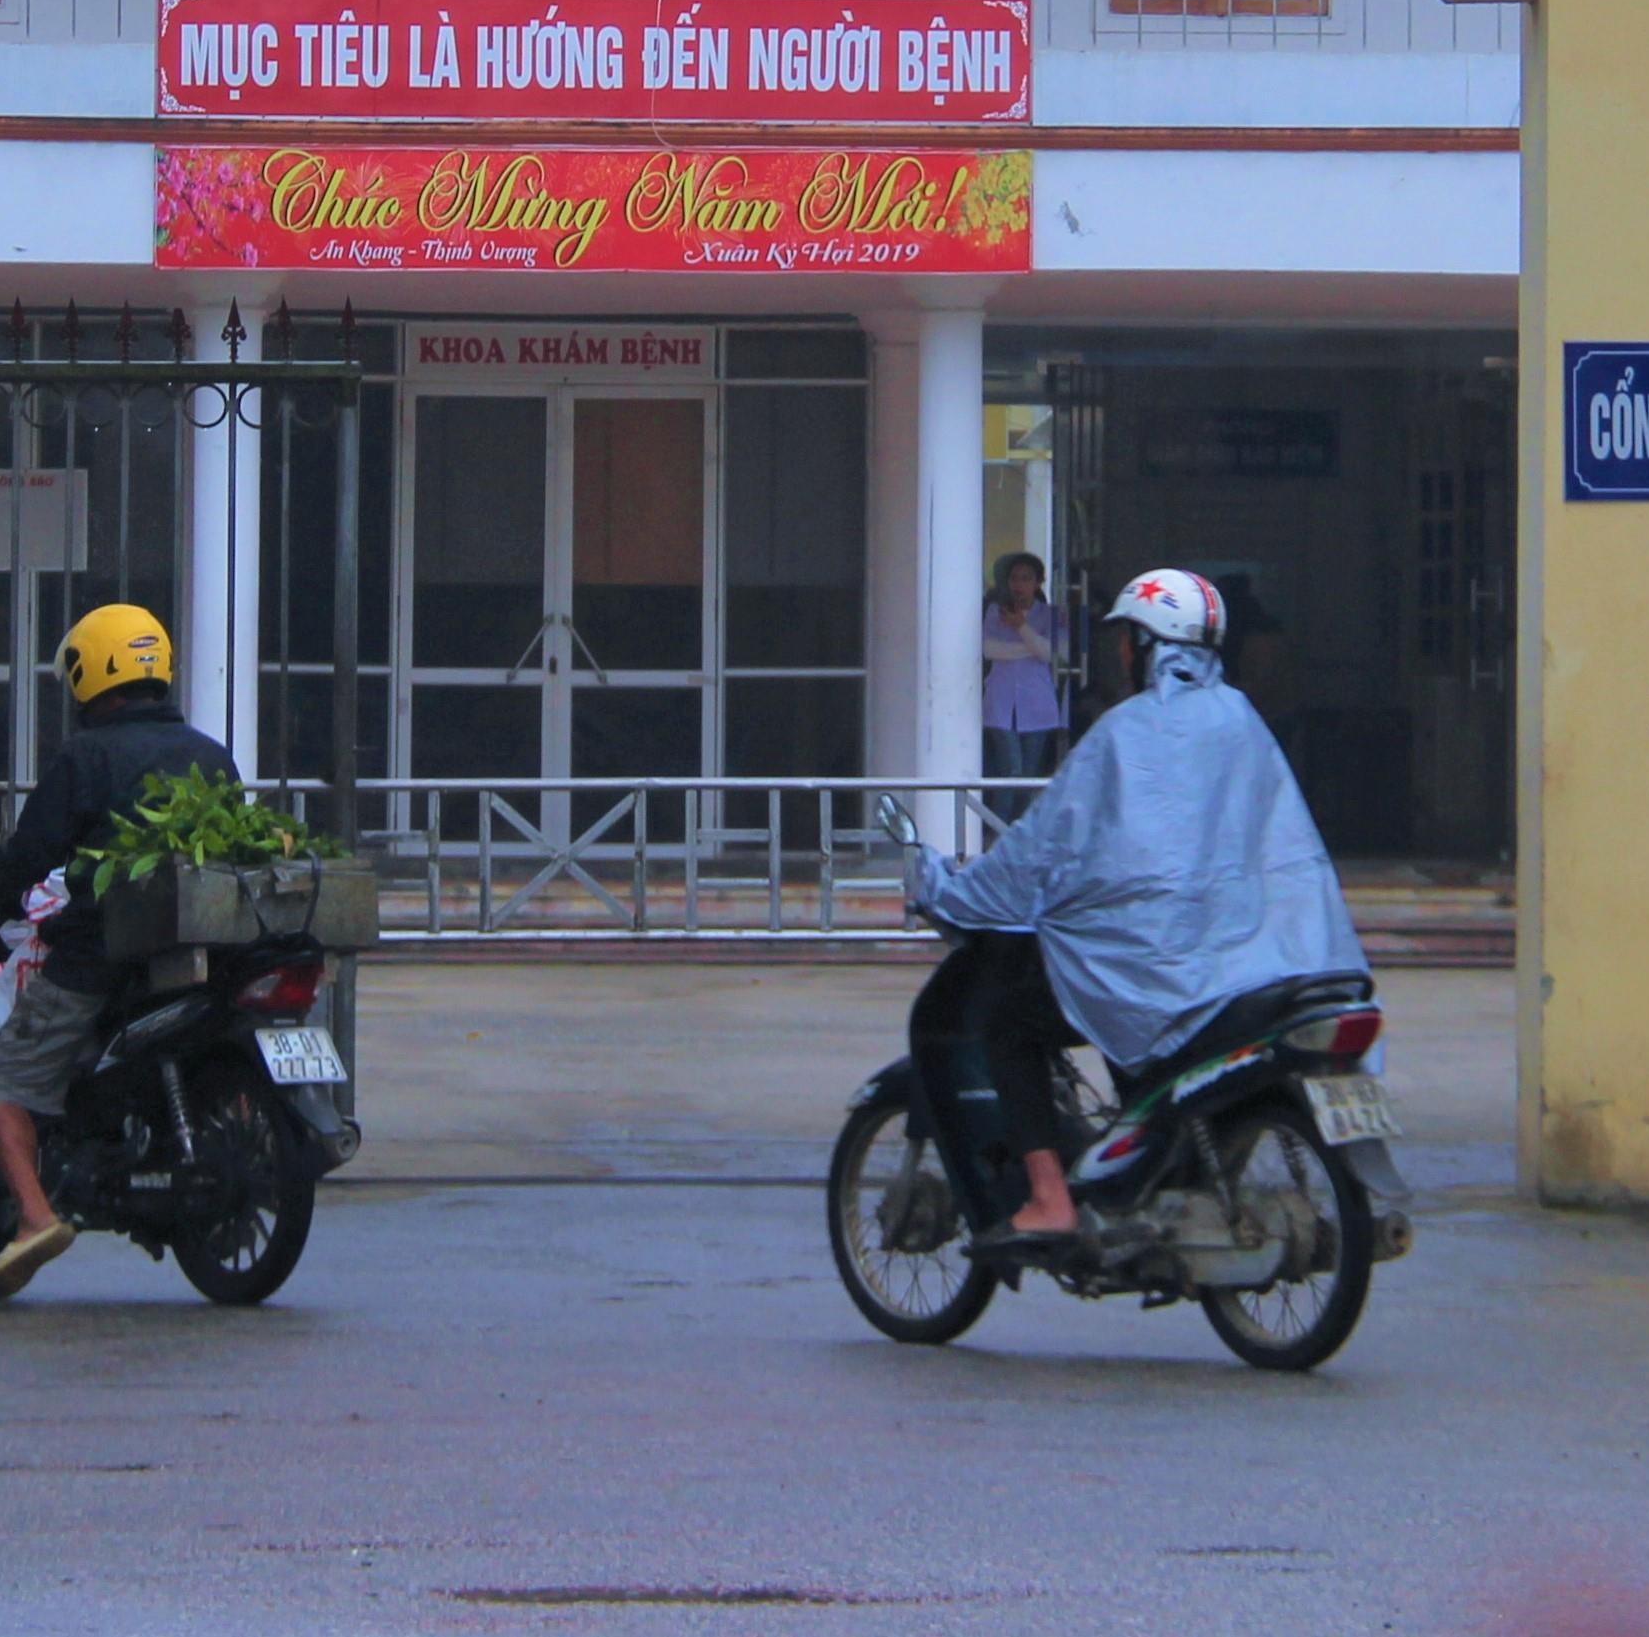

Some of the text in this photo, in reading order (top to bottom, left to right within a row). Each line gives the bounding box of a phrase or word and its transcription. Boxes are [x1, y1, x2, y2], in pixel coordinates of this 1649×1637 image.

[178, 3, 1010, 105] MỤC TIÊU LÀ HƯỚNG ĐẾN NGƯỜI BỆNH
[262, 148, 402, 233] Chúc
[417, 149, 611, 267] Mừng
[625, 151, 782, 234] Năm
[310, 240, 343, 261] An
[349, 240, 403, 266] Khang
[421, 239, 472, 263] Thịnh
[683, 241, 759, 264] Xuân
[801, 240, 854, 265] Hợi
[858, 243, 921, 263] 2019
[420, 331, 702, 370] KHOA KHÁM BỆNH
